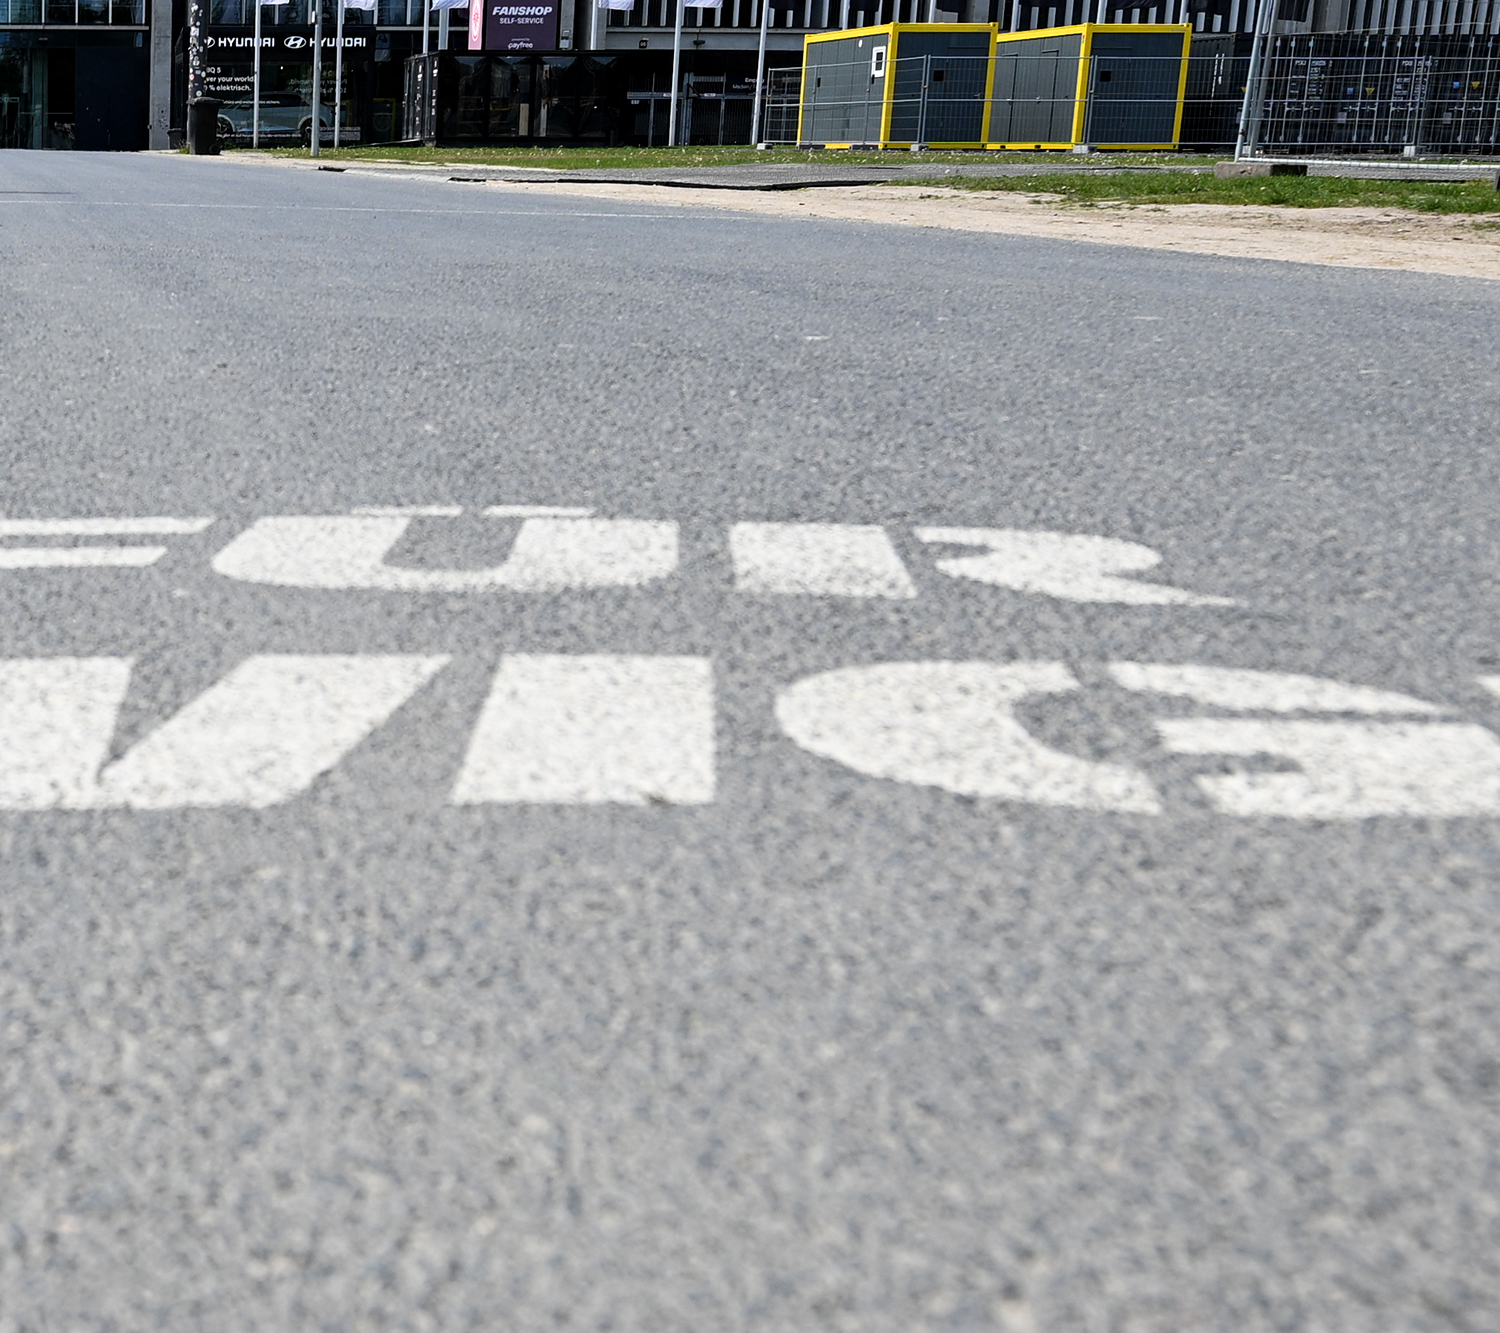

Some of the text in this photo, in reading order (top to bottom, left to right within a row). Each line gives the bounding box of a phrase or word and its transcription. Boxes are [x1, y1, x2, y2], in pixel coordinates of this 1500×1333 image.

[492, 6, 553, 16] FANSHOP
[218, 37, 275, 47] HYUNAI
[309, 37, 366, 47] HYUDAI
